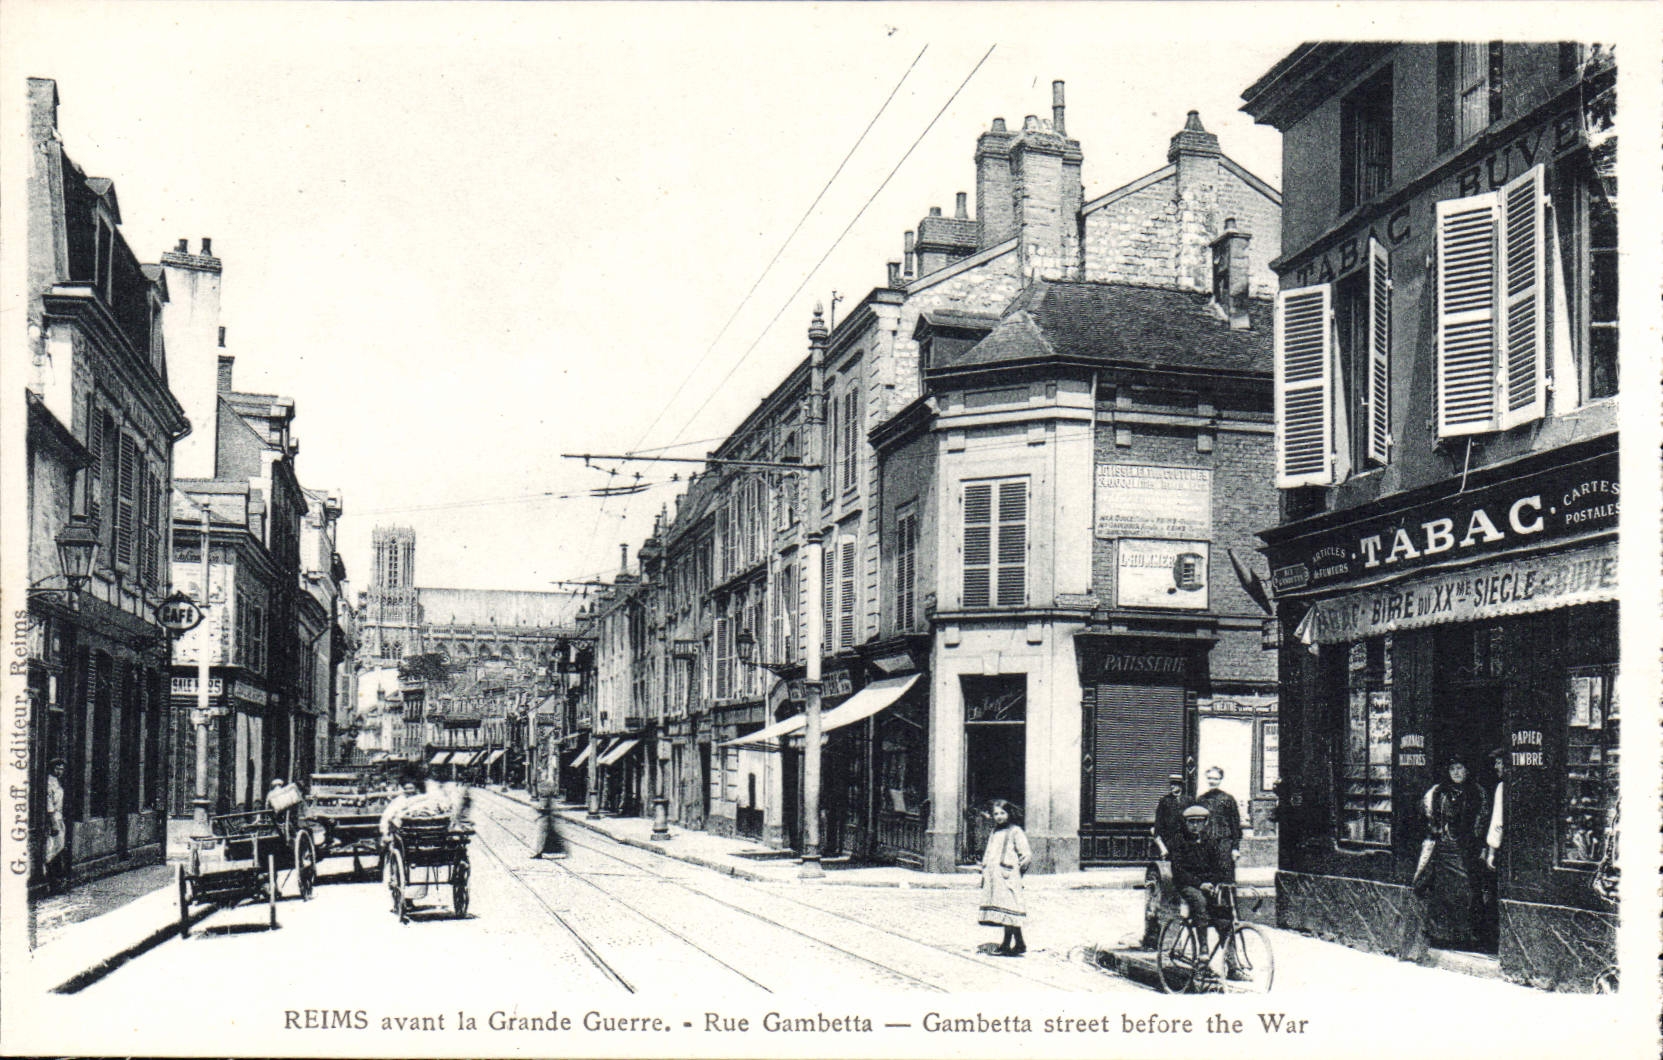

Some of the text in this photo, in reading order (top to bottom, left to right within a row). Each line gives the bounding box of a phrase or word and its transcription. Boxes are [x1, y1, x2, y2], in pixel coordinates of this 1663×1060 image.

[1297, 204, 1412, 286] TABAC
[1563, 480, 1620, 506] CARTES
[1565, 502, 1621, 525] POSTALES
[1360, 495, 1545, 568] TABAC
[1312, 547, 1346, 563] ARTICLES
[1474, 570, 1537, 607] SIECLE
[1104, 654, 1188, 673] PATISSERIE
[1512, 730, 1543, 747] PAPIER
